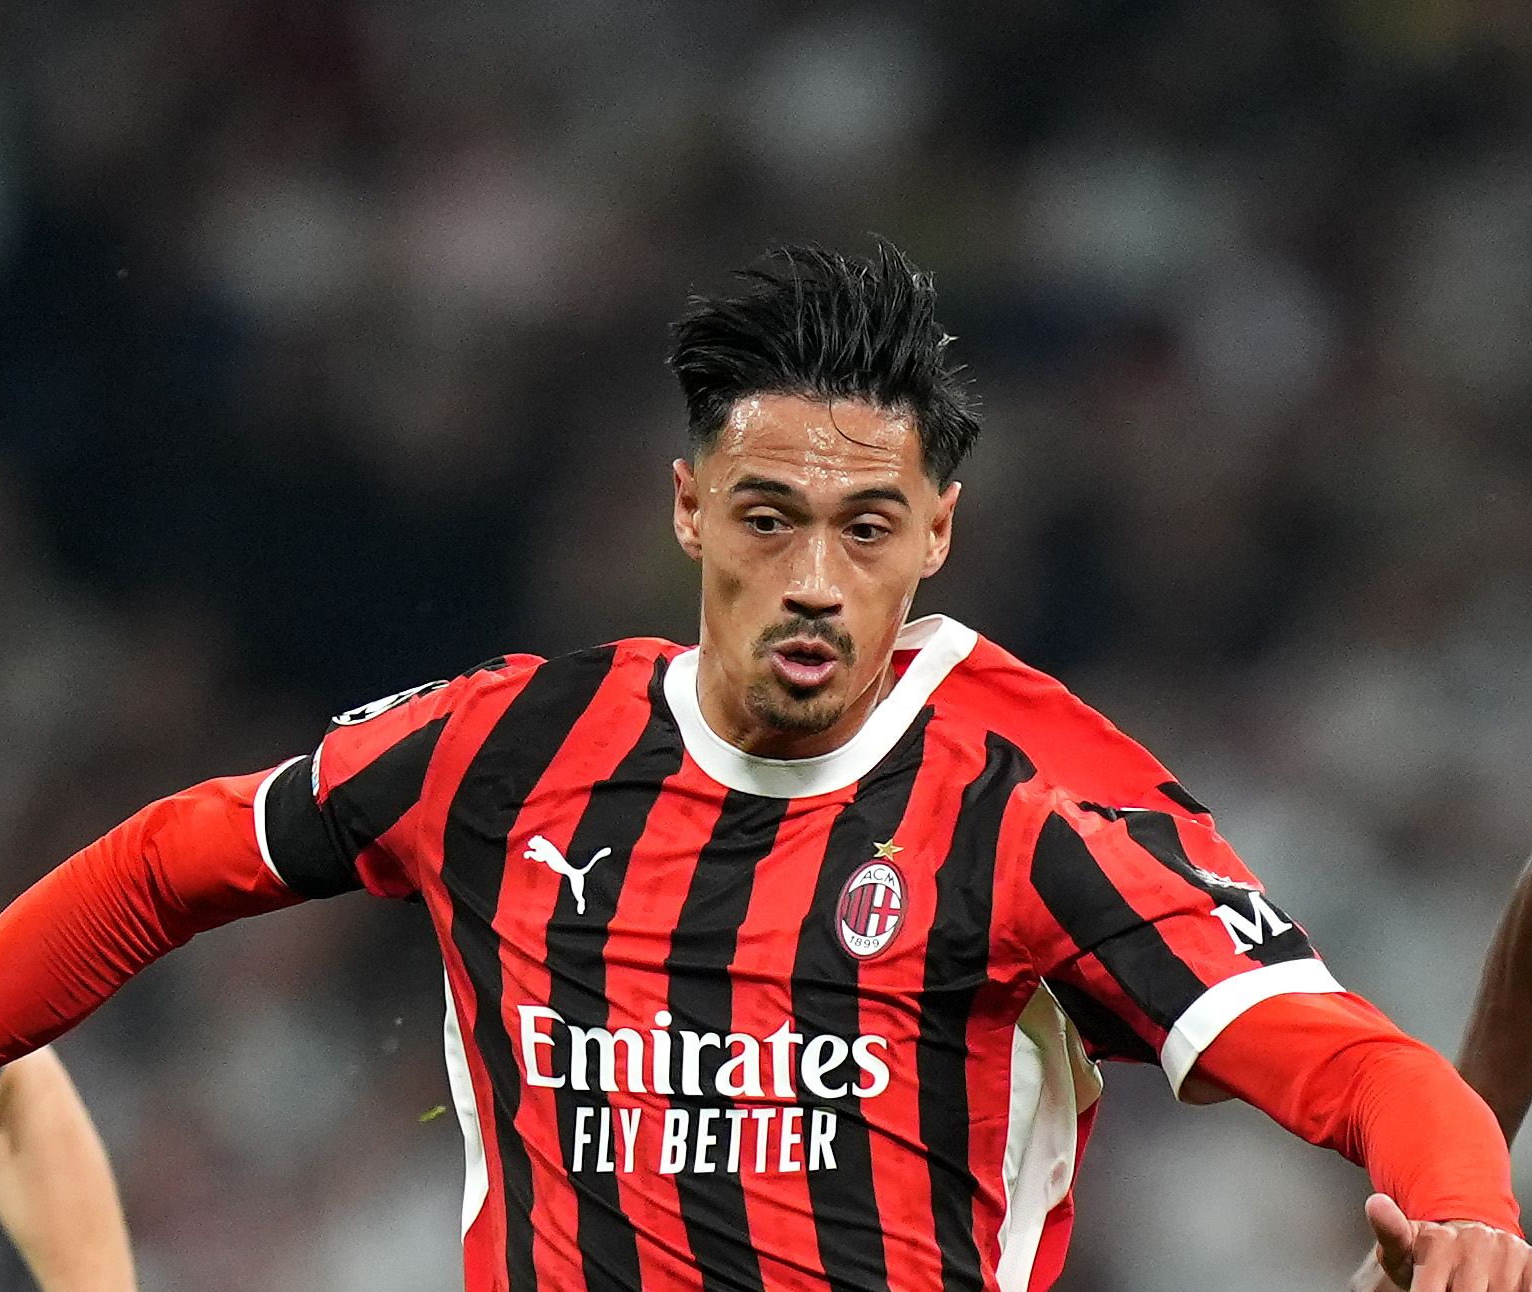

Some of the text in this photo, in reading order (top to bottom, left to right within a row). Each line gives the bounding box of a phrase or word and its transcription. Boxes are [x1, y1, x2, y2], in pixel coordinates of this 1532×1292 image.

[859, 867, 896, 887] ACM
[849, 935, 880, 949] 1899
[516, 1004, 891, 1099] Emirates
[572, 1106, 838, 1175] FLY BETTER
